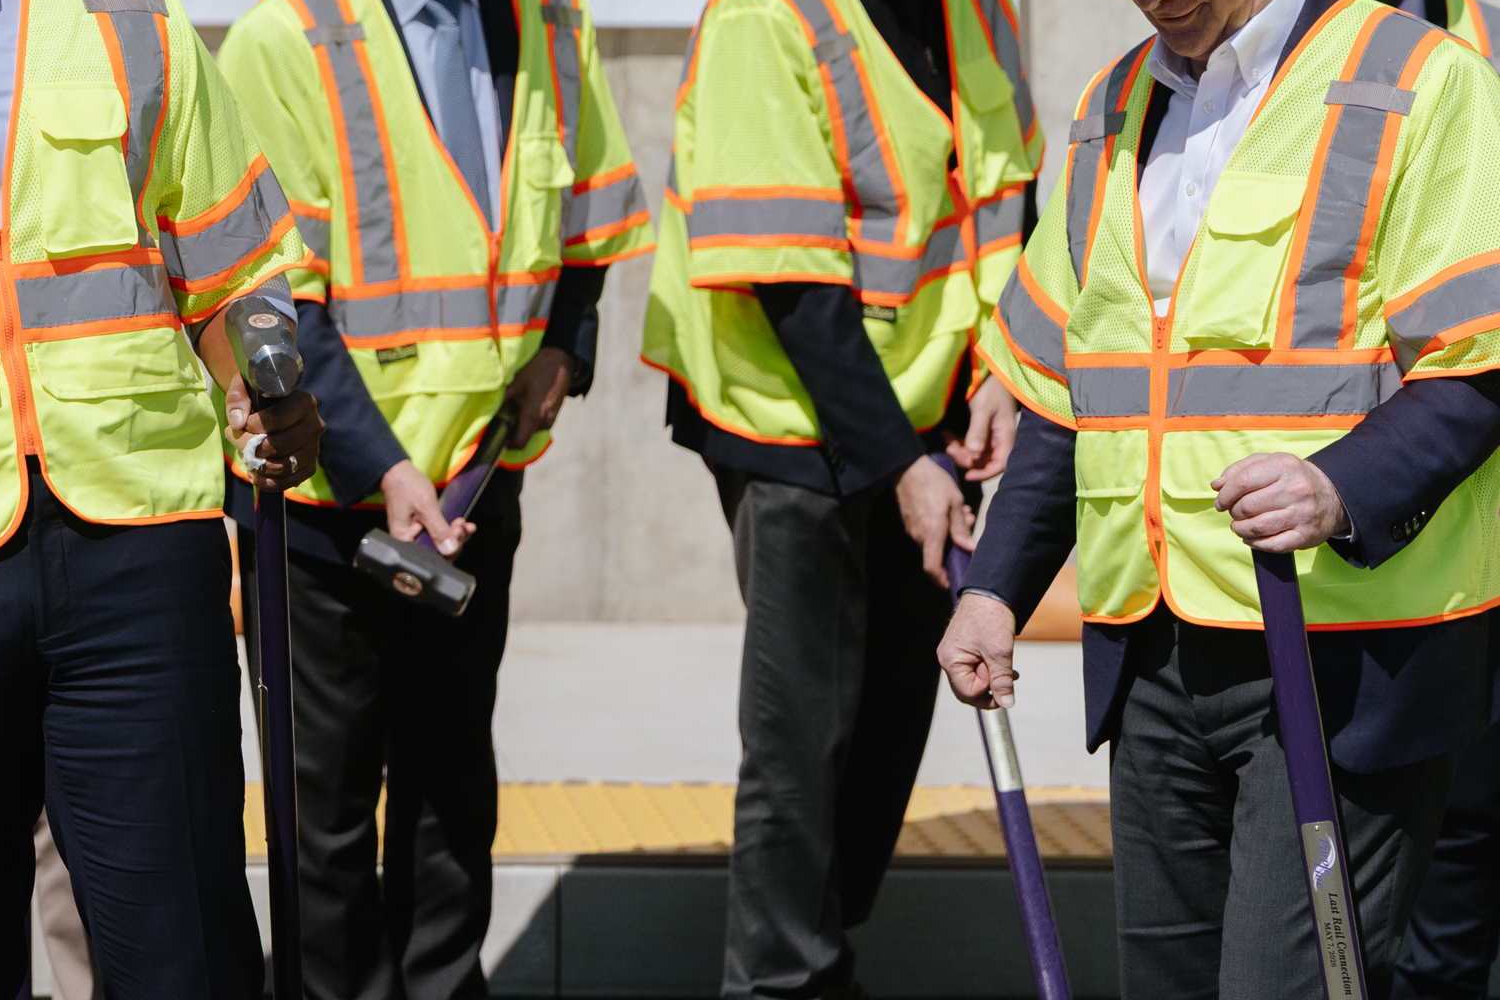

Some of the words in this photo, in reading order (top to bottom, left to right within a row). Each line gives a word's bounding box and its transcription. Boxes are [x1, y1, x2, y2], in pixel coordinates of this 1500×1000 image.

[1328, 892, 1341, 918] Last
[1324, 922, 1334, 941] MAY
[1329, 951, 1338, 968] 2026
[1333, 917, 1346, 940] Rail
[1336, 941, 1353, 996] Connection
